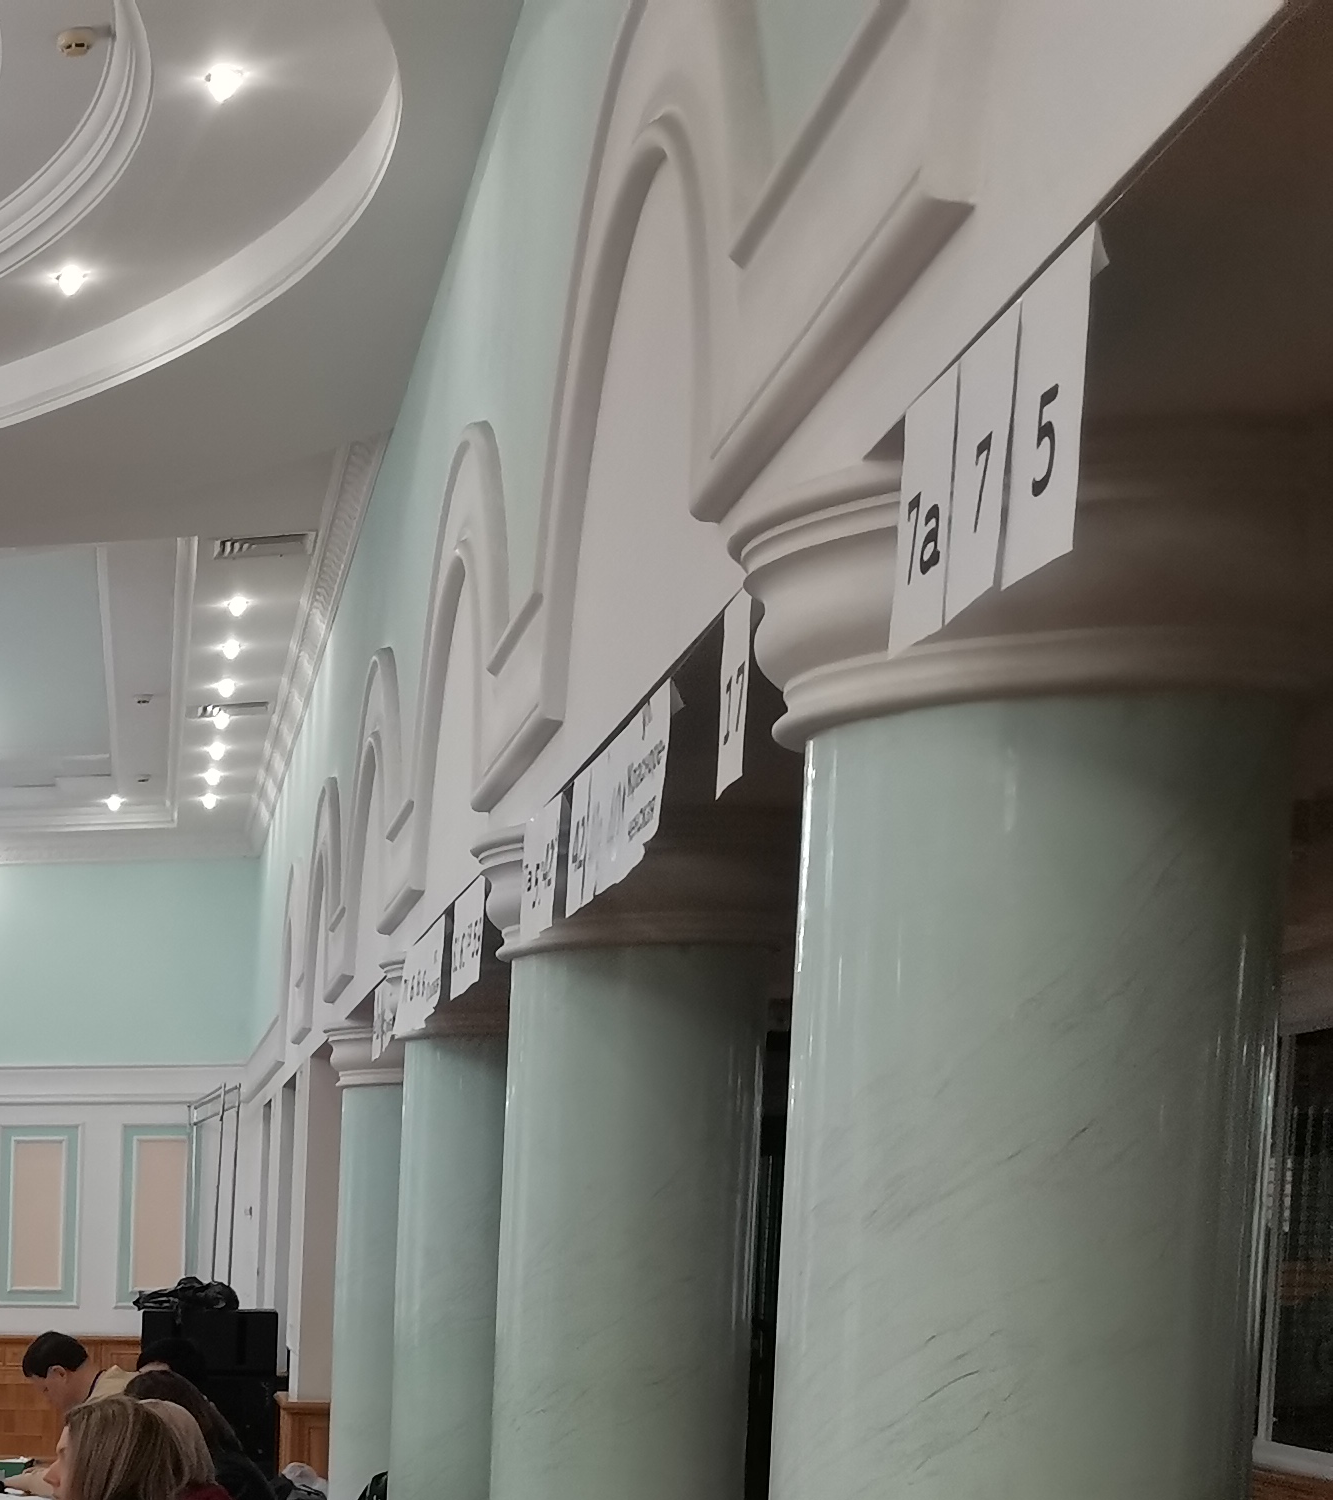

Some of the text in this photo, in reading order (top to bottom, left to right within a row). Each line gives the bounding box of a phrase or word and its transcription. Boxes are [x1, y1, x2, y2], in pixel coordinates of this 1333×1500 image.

[974, 431, 993, 534] 7
[1032, 383, 1059, 497] 5
[723, 660, 746, 746] 17
